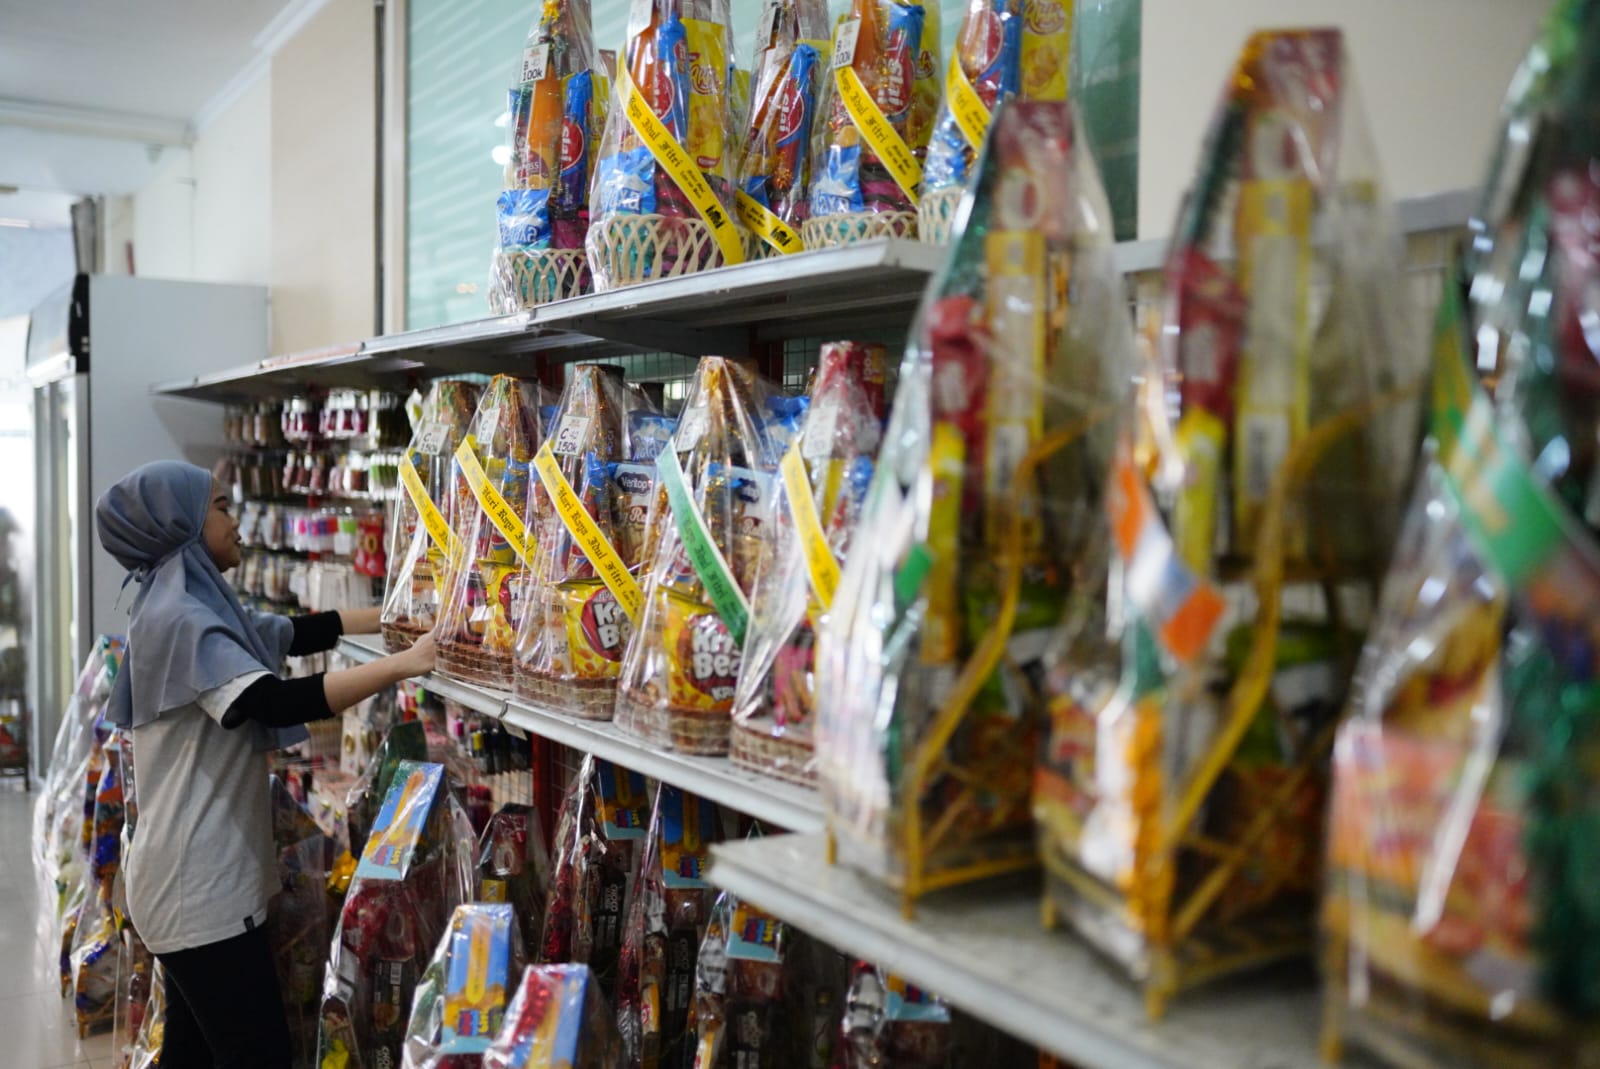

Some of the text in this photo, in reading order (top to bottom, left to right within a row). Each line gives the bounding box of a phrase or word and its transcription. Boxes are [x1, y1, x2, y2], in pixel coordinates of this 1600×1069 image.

[522, 70, 542, 82] 100k
[561, 428, 569, 440] C
[557, 441, 578, 454] 150k
[586, 536, 608, 560] Idul
[603, 560, 626, 588] Fitri
